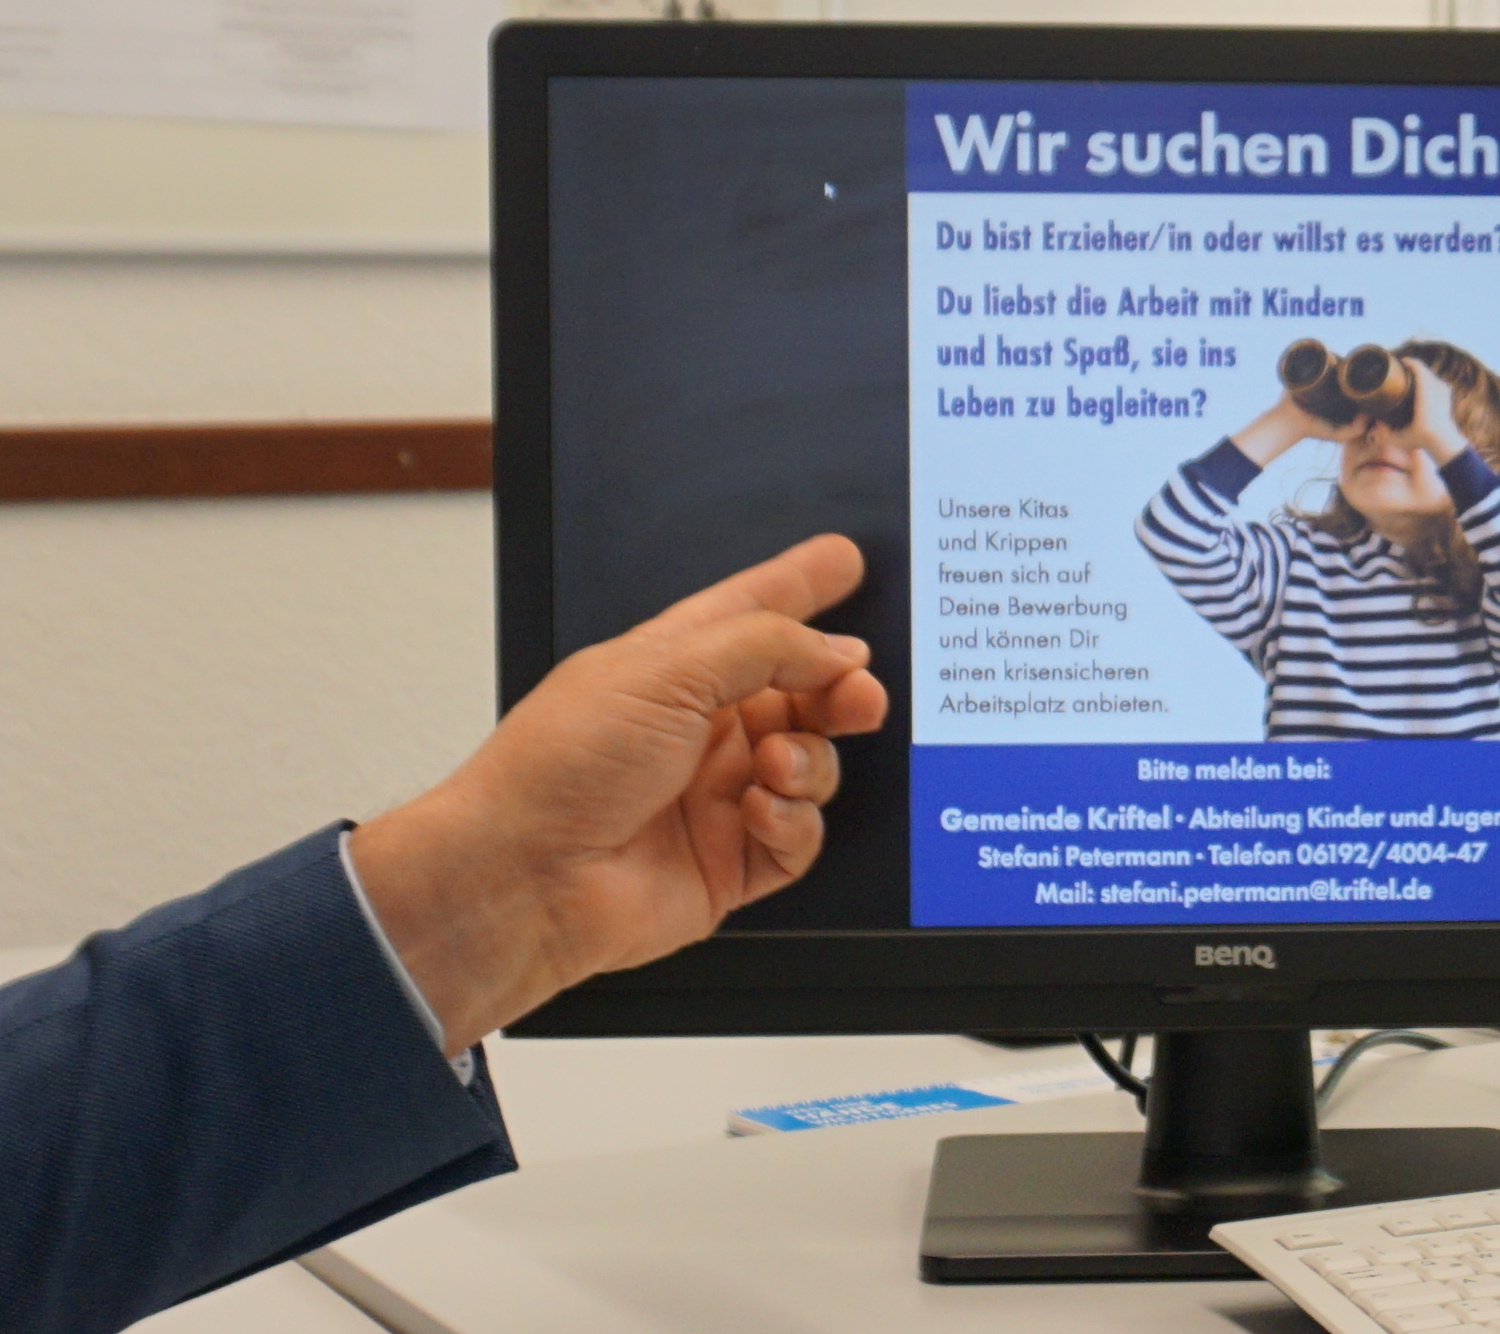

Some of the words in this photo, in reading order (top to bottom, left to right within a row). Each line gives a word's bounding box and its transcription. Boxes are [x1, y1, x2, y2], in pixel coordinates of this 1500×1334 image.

[934, 110, 1068, 174] Wir
[1085, 110, 1328, 176] suchen
[936, 220, 972, 252] Du
[983, 218, 1032, 252] bist
[1042, 218, 1193, 253] Erzieher/in
[1202, 220, 1263, 253] oder
[1273, 221, 1347, 254] willst
[1355, 232, 1385, 254] es
[936, 286, 973, 317] Du
[983, 283, 1057, 317] liebst
[1066, 284, 1107, 317] die
[1117, 285, 1200, 317] Arbeit
[1209, 287, 1253, 317] mit
[1262, 285, 1365, 318] Kindern
[936, 334, 986, 367] und
[996, 334, 1053, 368] hast
[1063, 335, 1139, 377] Spaß,
[1151, 338, 1188, 368] sie
[1198, 337, 1237, 368] ins
[937, 385, 1015, 418] Leben
[1026, 396, 1056, 418] zu
[1066, 385, 1208, 427] begleiten?
[938, 499, 1011, 518] Unsere
[1018, 499, 1069, 519] Kitas
[938, 530, 977, 551] und
[985, 532, 1068, 556] Krippen
[938, 562, 1004, 584] freuen
[1011, 563, 1051, 584] sich
[1057, 562, 1091, 584] auf
[939, 597, 1000, 617] Deine
[1008, 595, 1128, 621] Bewerbung
[939, 629, 978, 649] und
[986, 629, 1062, 649] können
[1069, 629, 1100, 649] Dir
[939, 662, 997, 681] einen
[1003, 660, 1149, 682] krisensicheren
[939, 694, 1066, 718] Arbeitsplatz
[1071, 694, 1168, 713] anbieten.
[1137, 758, 1191, 782] Bitte
[1193, 755, 1282, 781] melden
[1285, 755, 1331, 781] bei:
[939, 804, 1082, 833] Gemeinde
[1087, 804, 1172, 831] Kriftel
[1187, 805, 1303, 835] Abteilung
[1305, 804, 1386, 829] Kinder
[1389, 804, 1437, 829] und
[977, 843, 1061, 869] Stefani
[1064, 845, 1192, 868] Petermann
[1207, 841, 1292, 867] Telefon
[1295, 840, 1488, 870] 06192/4004-47
[1034, 880, 1095, 905] Mail:
[1100, 877, 1433, 909] stefani.petermann@kriftel.de
[1195, 945, 1276, 969] BenQ
